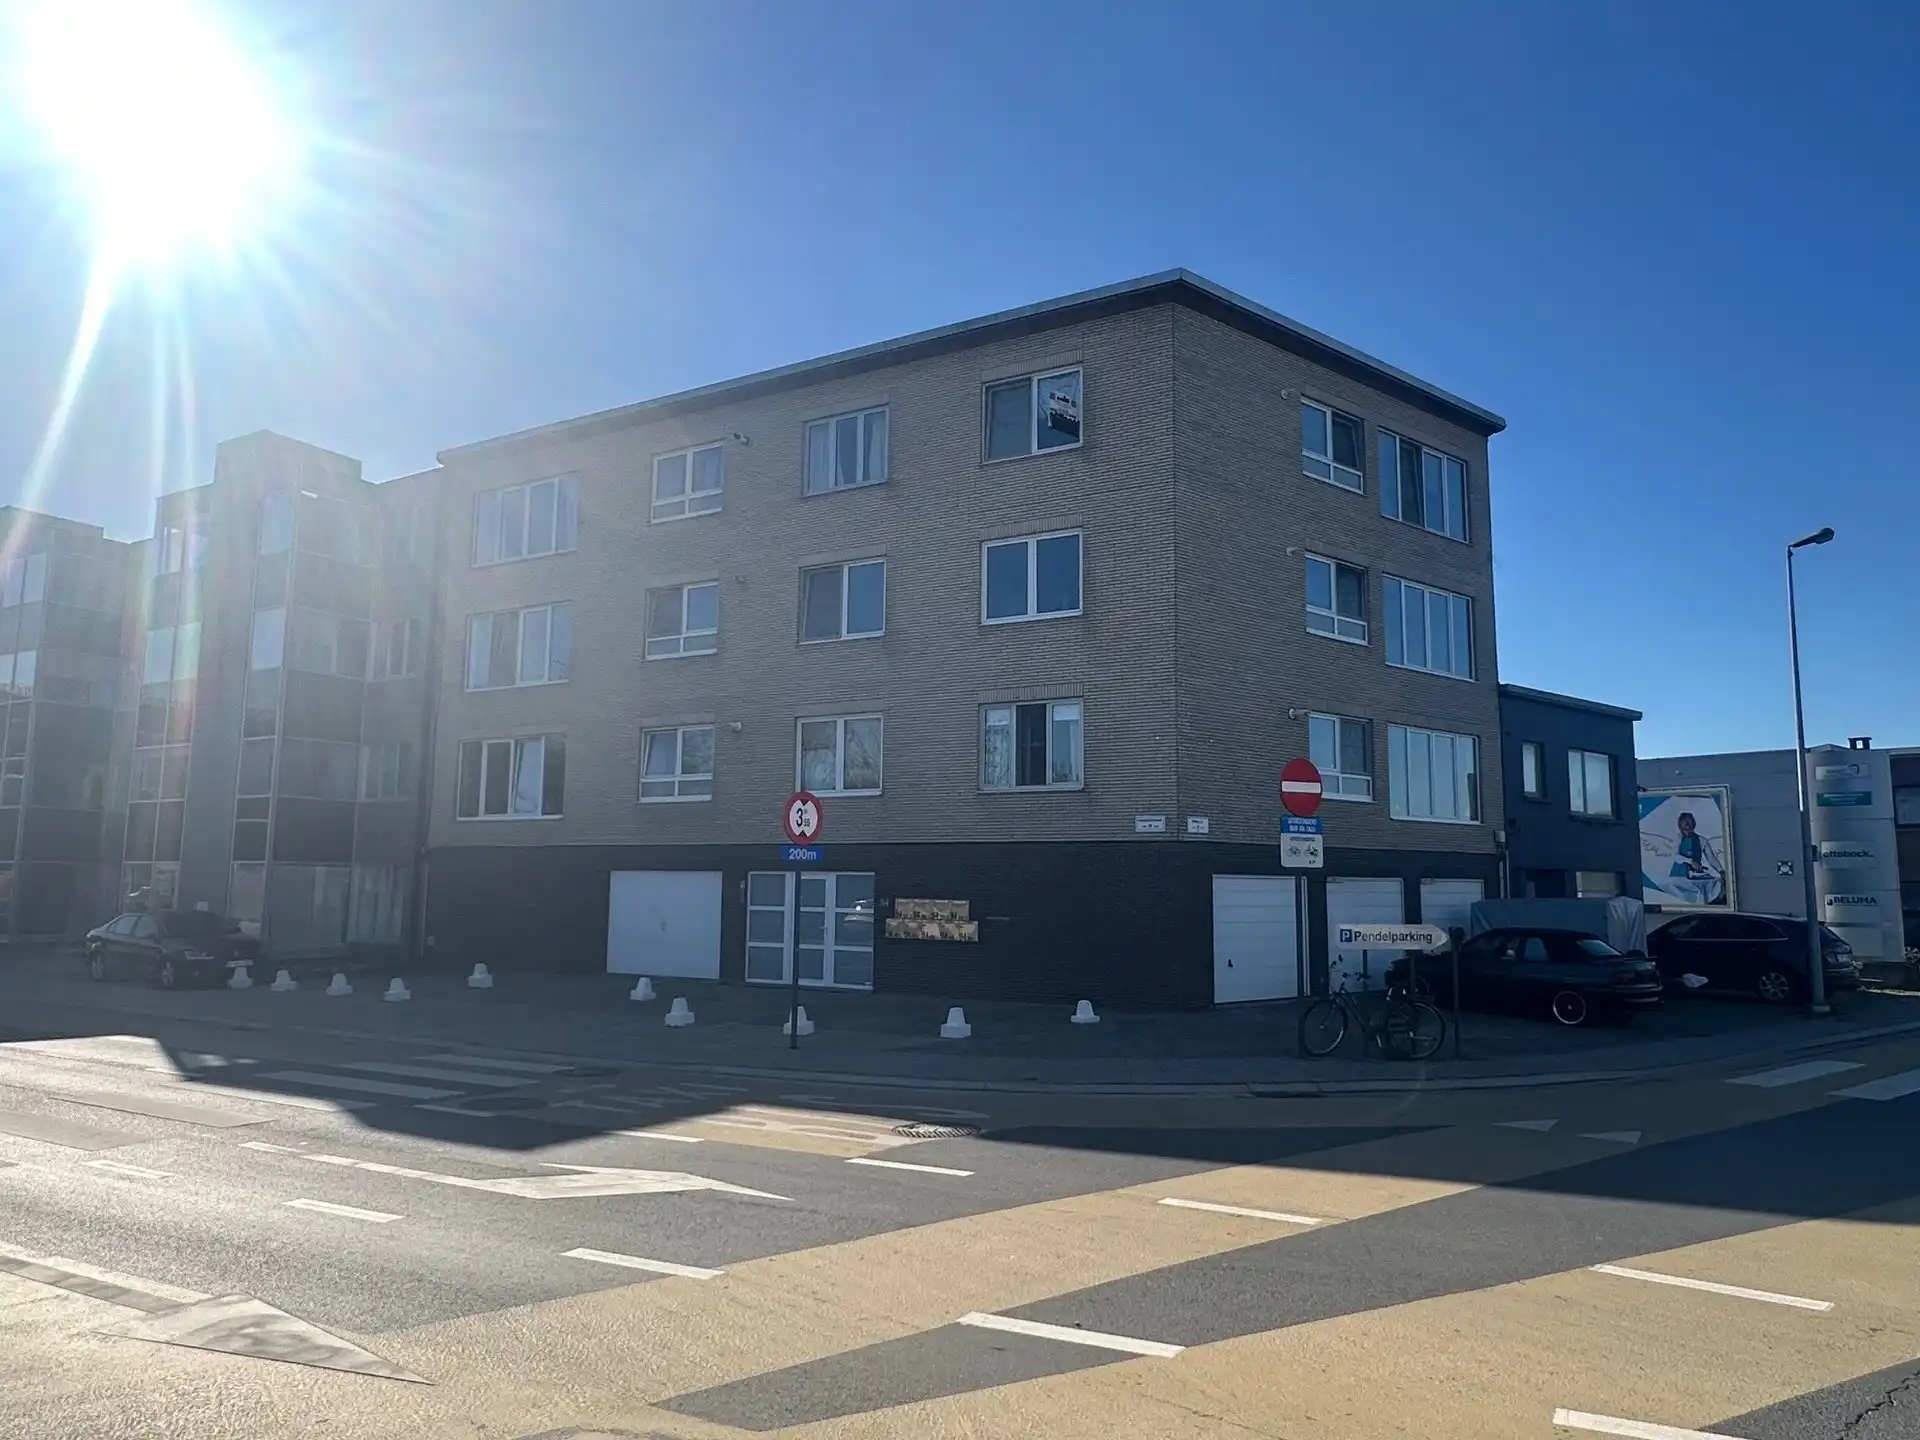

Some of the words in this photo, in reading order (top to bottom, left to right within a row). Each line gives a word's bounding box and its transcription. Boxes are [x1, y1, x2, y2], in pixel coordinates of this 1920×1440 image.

[796, 808, 803, 827] 3
[789, 848, 817, 860] 200m
[1833, 896, 1877, 904] BELUMA
[1354, 931, 1433, 944] Pendelparking
